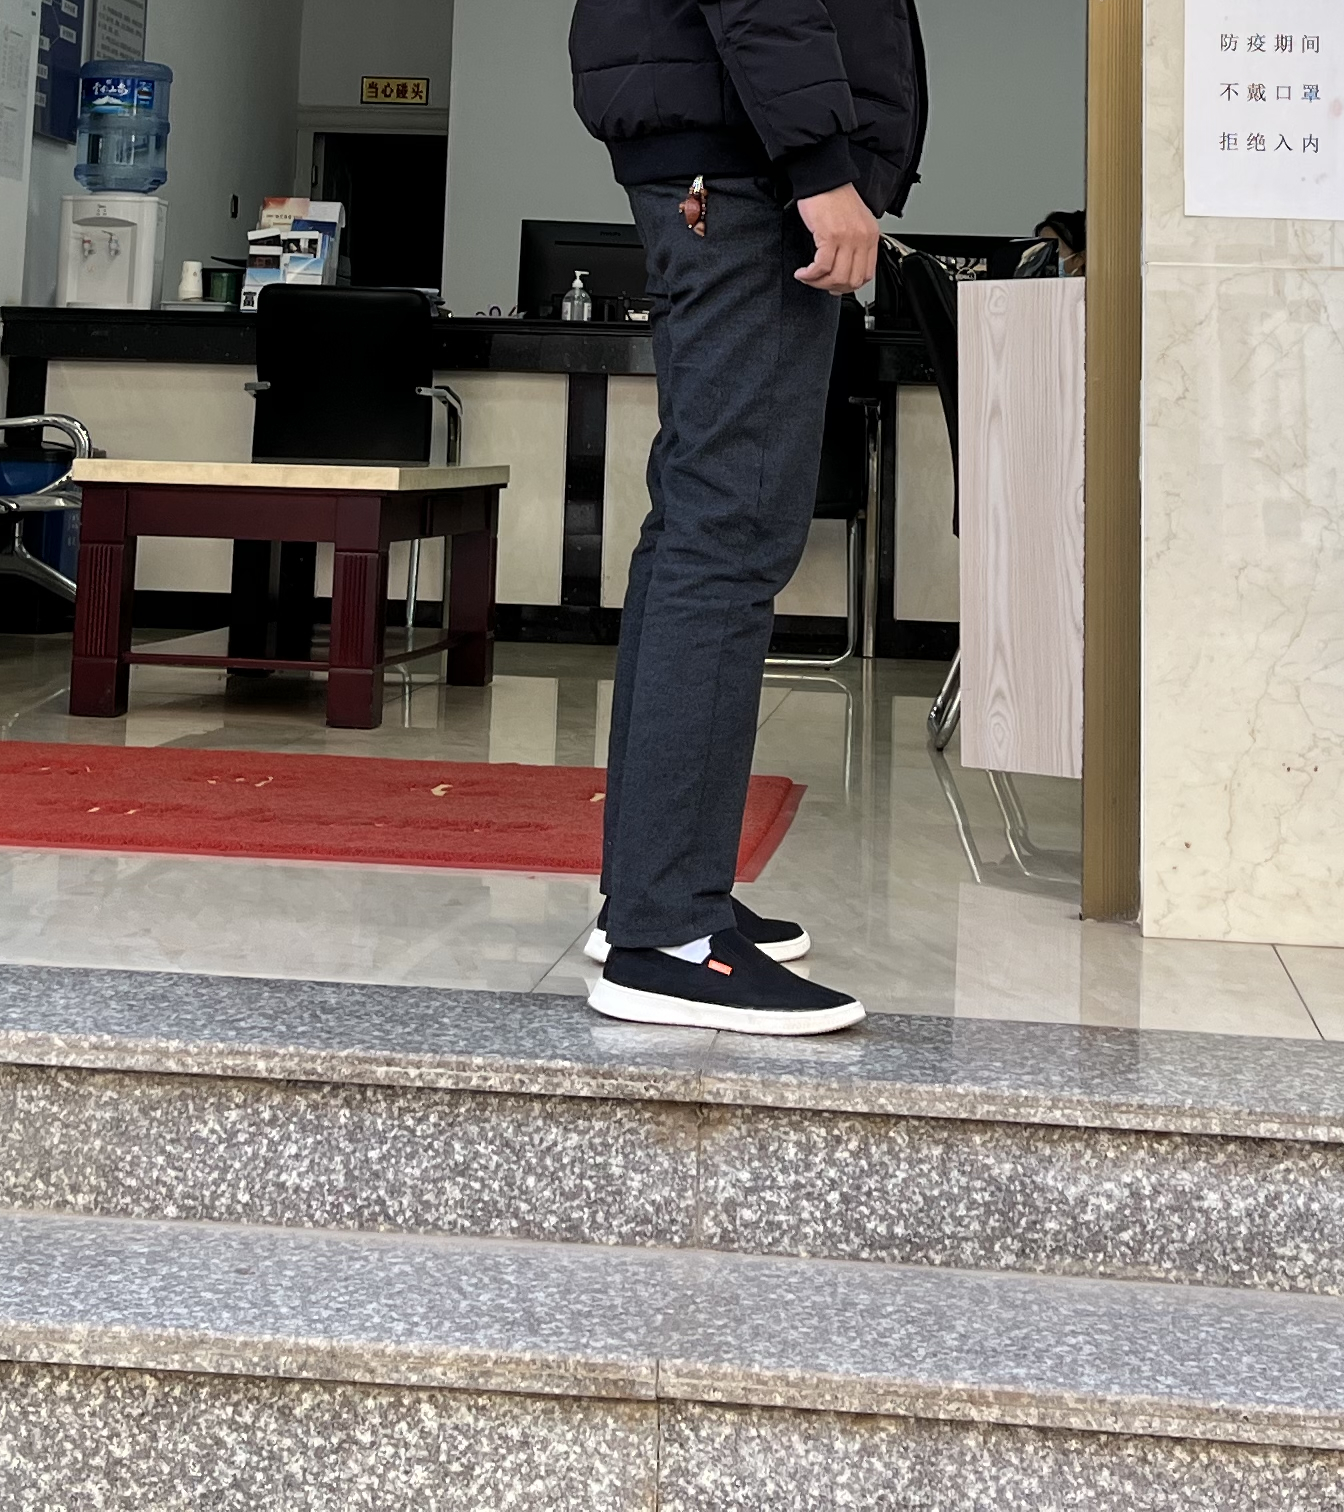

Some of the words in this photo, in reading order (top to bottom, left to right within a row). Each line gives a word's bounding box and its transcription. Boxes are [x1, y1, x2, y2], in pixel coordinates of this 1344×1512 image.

[1220, 33, 1320, 54] 防疫期间
[366, 81, 424, 100] 当心碰头
[1219, 82, 1321, 103] 不戴口罩
[1219, 132, 1319, 154] 拒绝入内
